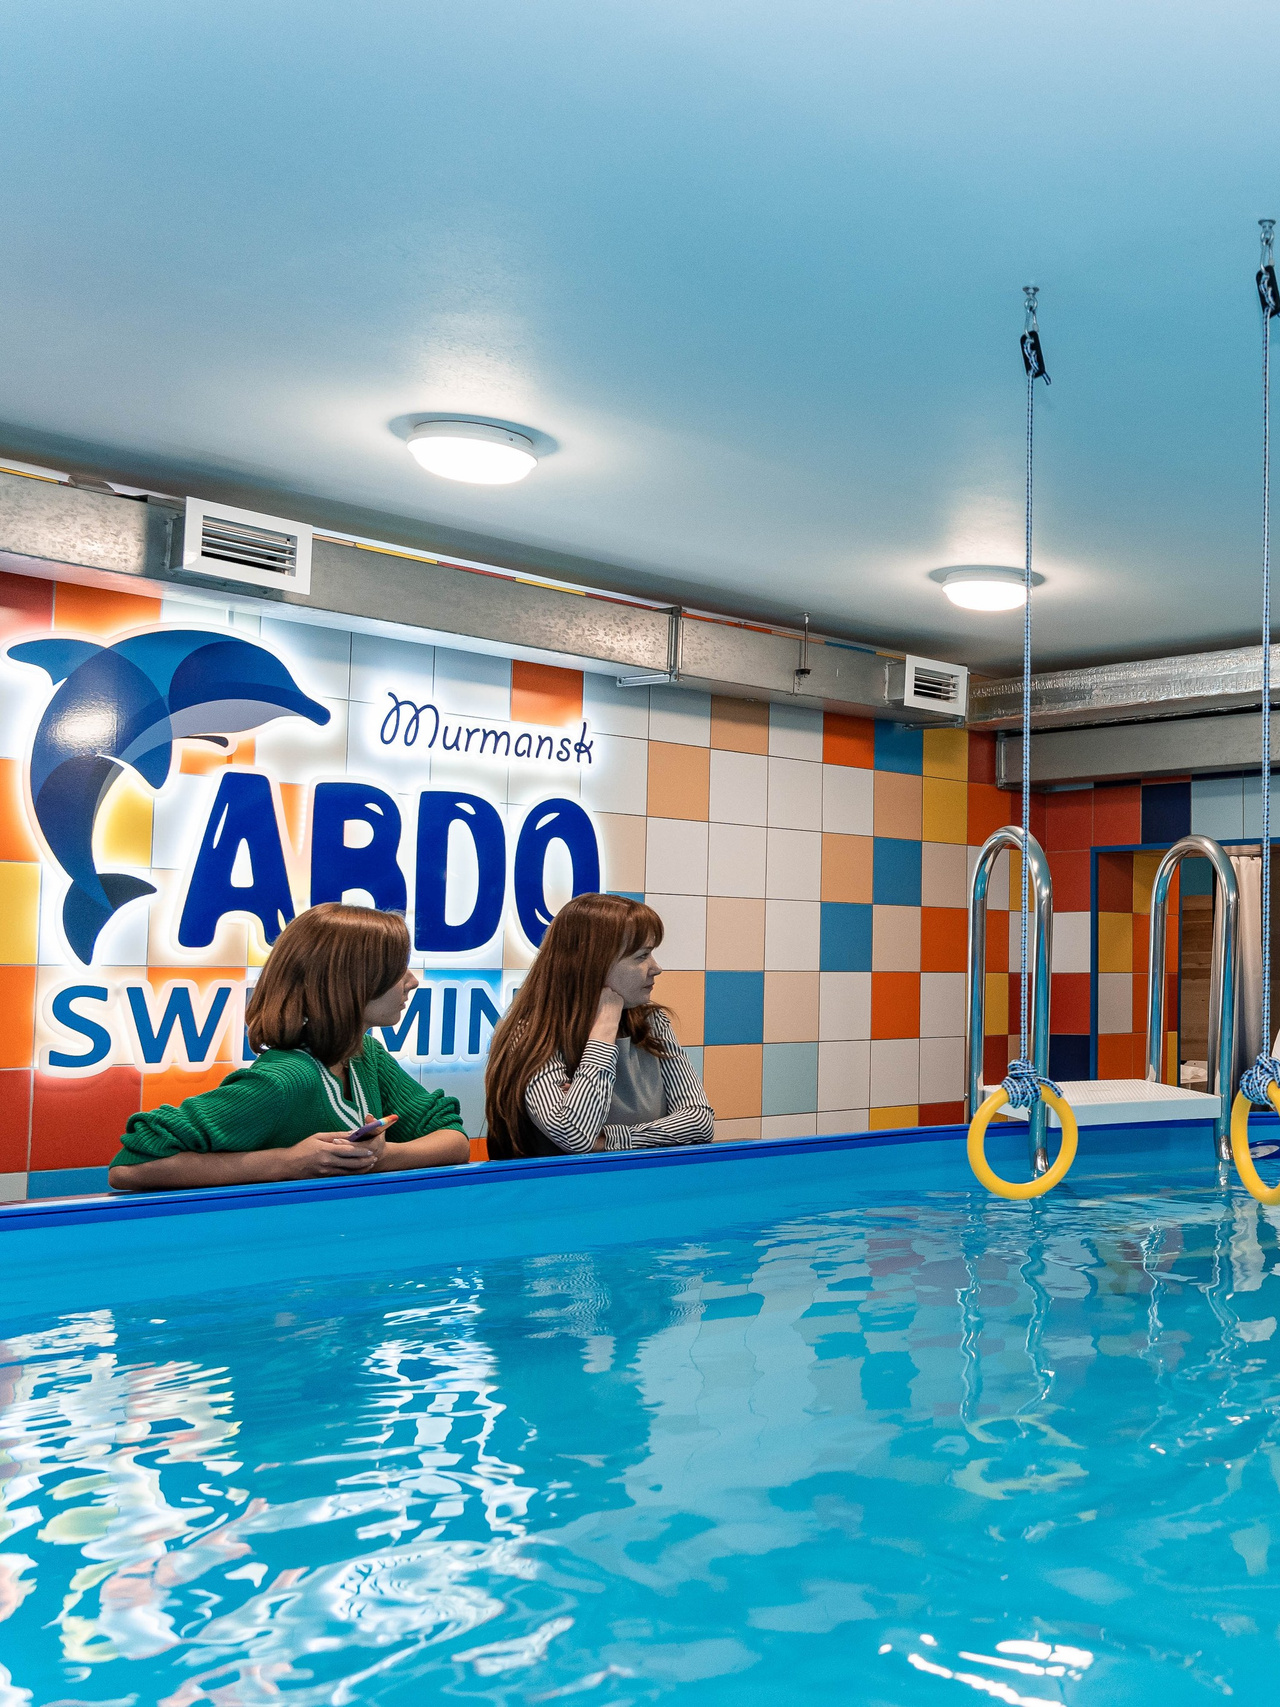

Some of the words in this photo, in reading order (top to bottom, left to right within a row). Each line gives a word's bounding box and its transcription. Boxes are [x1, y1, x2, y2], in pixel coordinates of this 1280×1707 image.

[380, 691, 594, 764] Murmansk
[178, 772, 600, 952] ABDO
[48, 985, 519, 1067] SWMIN
